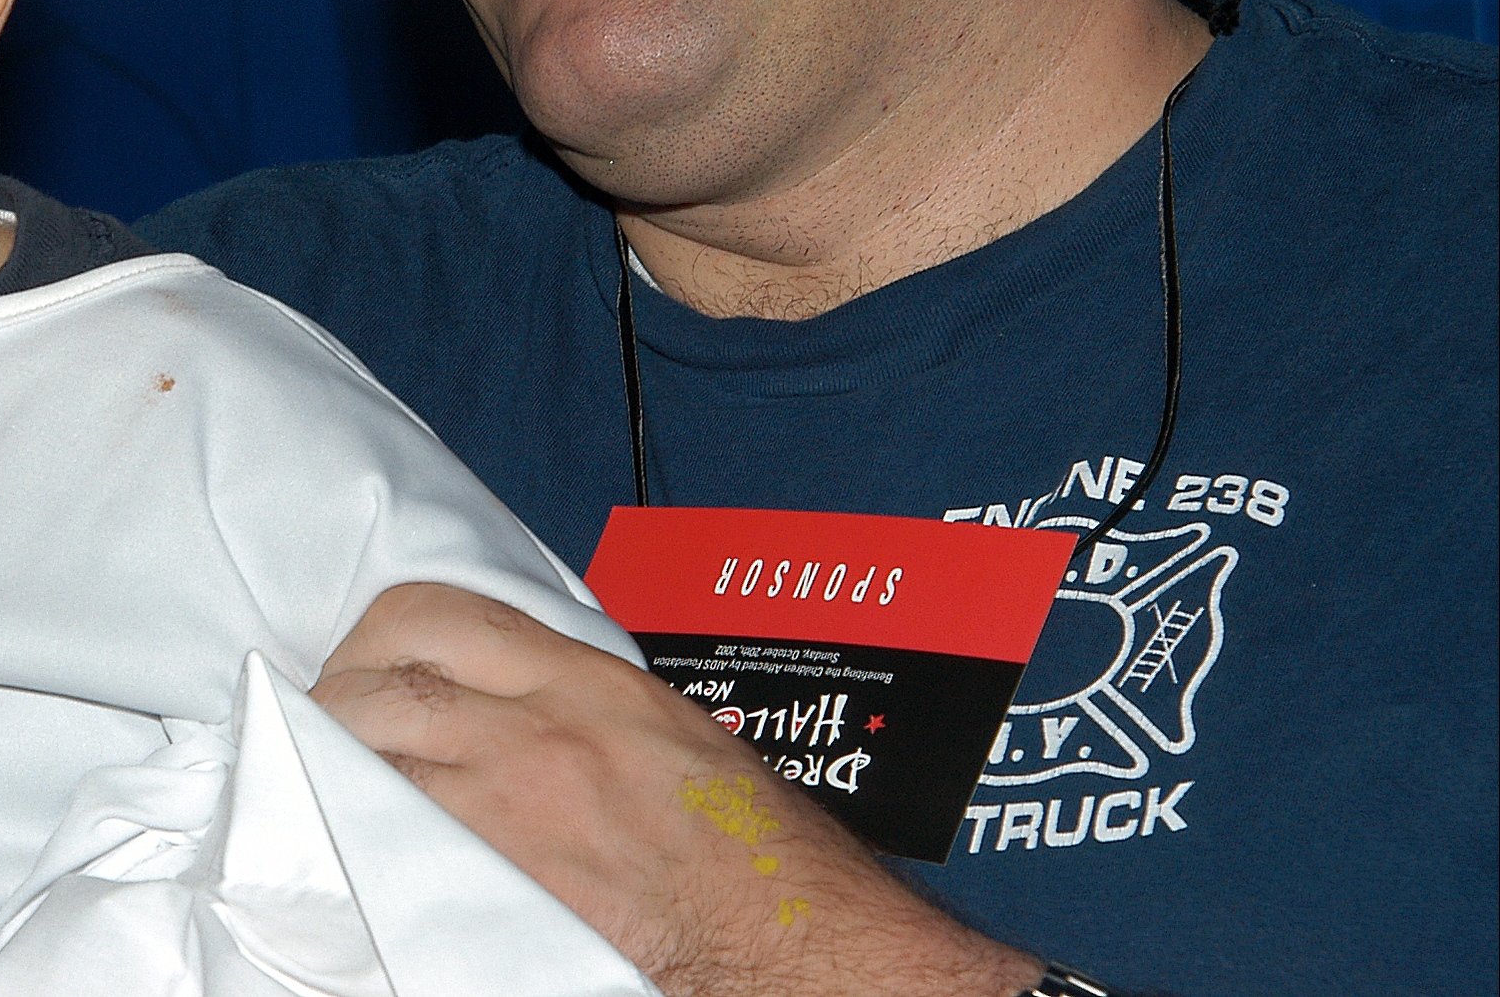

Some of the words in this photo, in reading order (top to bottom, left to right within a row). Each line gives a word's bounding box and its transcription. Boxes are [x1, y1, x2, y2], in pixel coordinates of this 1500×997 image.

[1167, 473, 1290, 528] 238
[713, 556, 904, 606] SPONSOR
[714, 644, 738, 656] 2002
[761, 647, 801, 661] October
[802, 647, 841, 663] Sunday,
[653, 656, 704, 669] Foundation
[703, 658, 729, 671] AIDS
[728, 657, 742, 673] by
[741, 660, 782, 675] Affected
[782, 662, 824, 678] Children
[824, 664, 842, 679] the
[841, 666, 895, 685] Benefiting
[964, 780, 1196, 854] TRUCK
